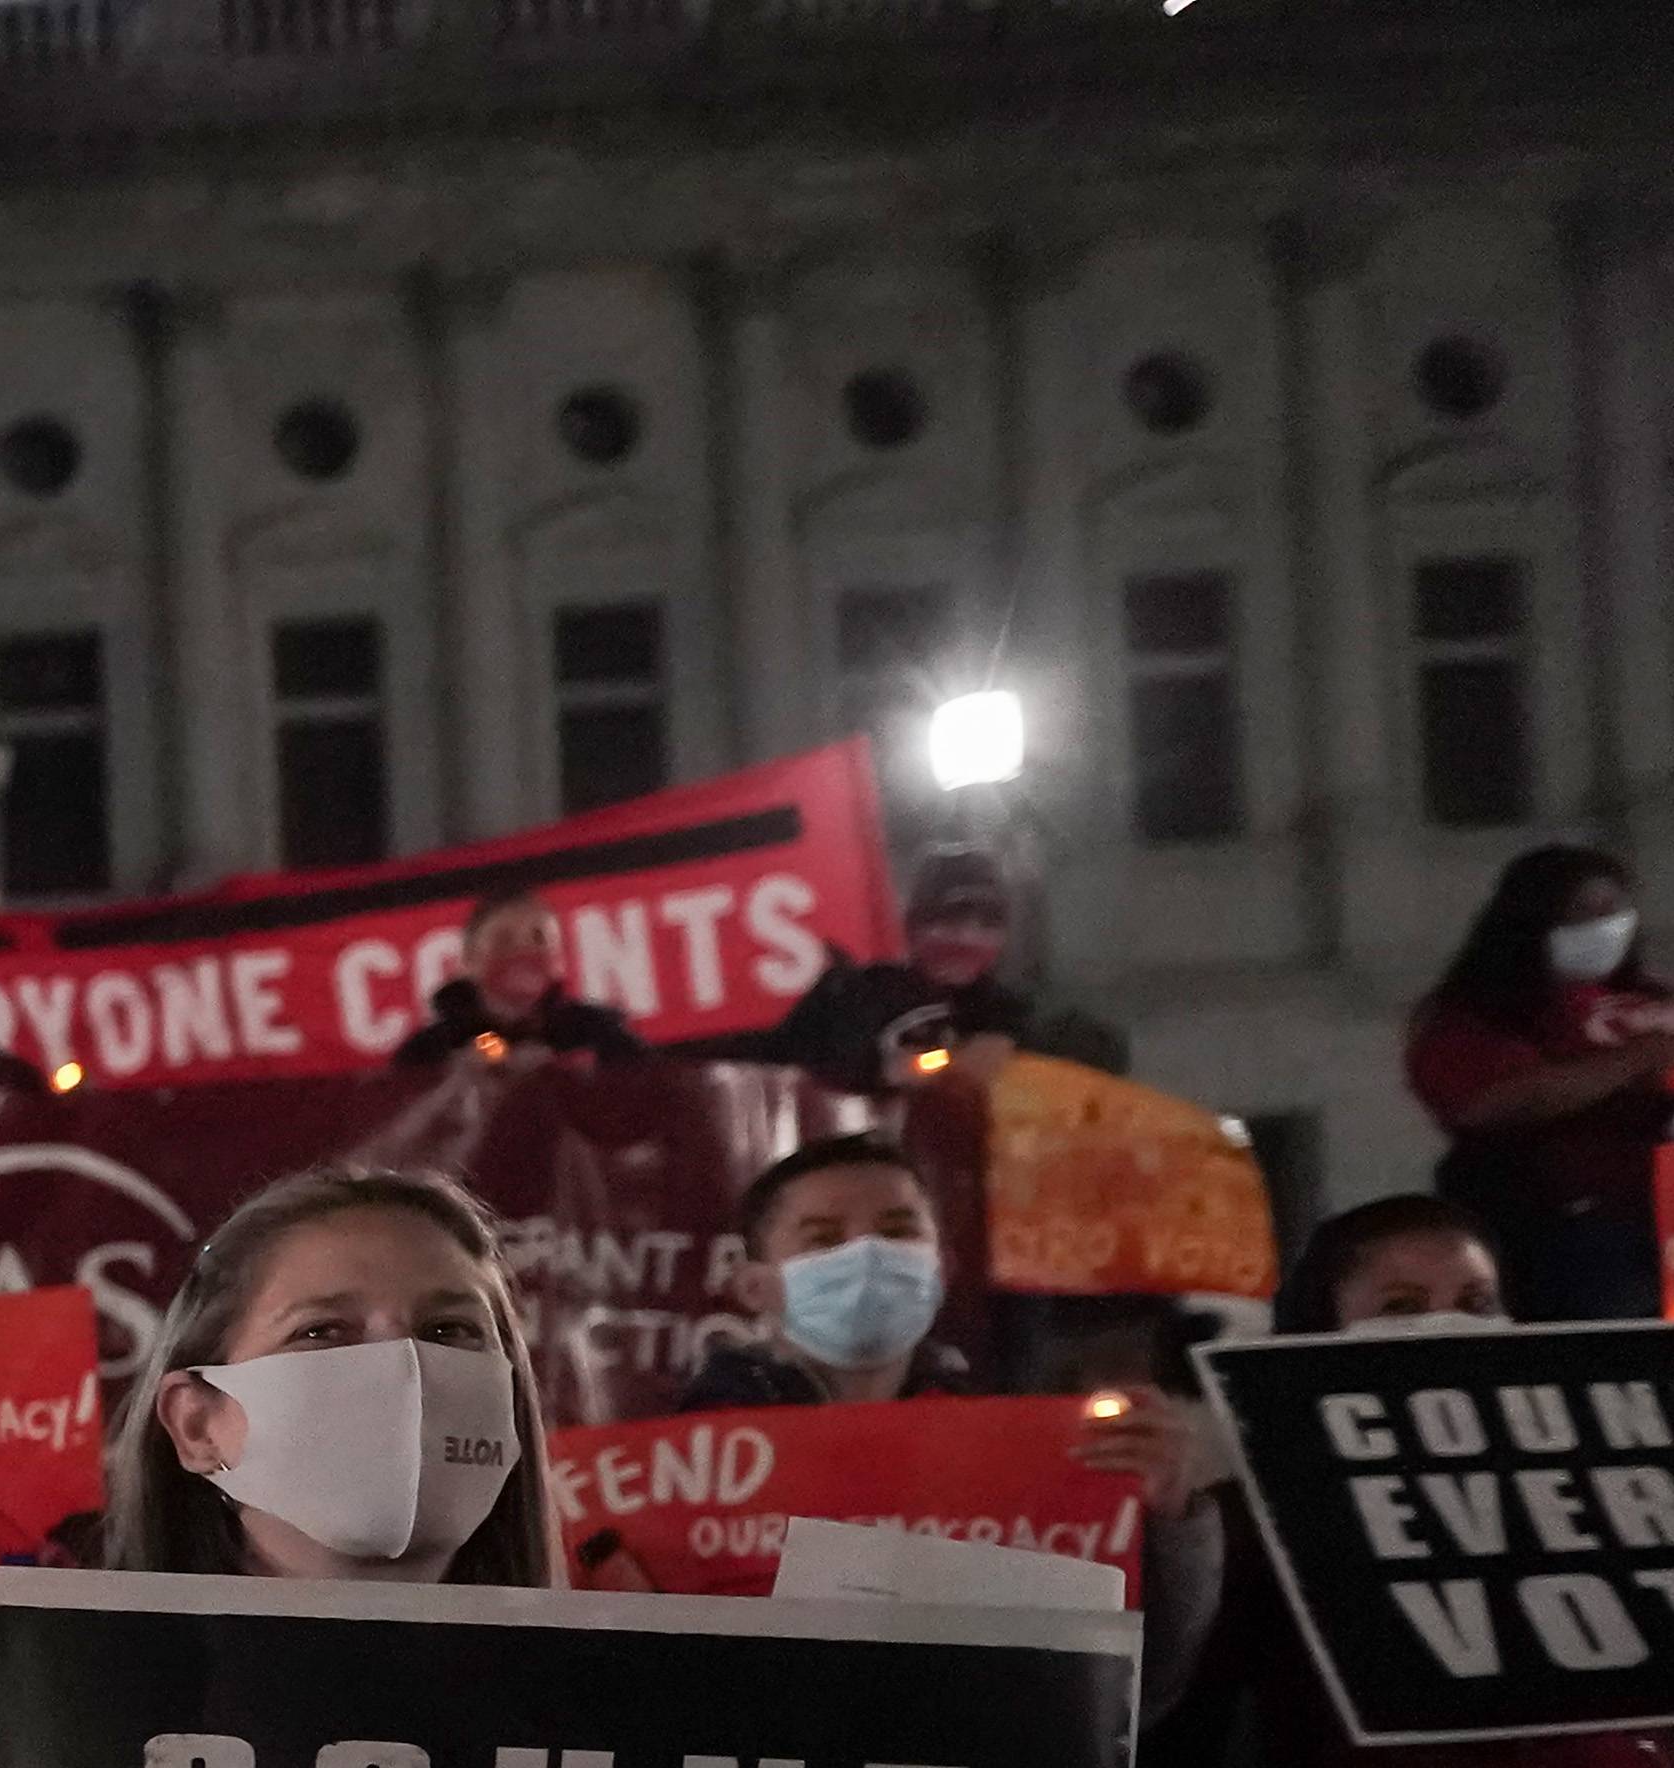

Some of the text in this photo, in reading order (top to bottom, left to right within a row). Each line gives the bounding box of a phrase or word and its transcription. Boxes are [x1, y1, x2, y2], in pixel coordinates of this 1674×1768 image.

[335, 873, 827, 1053] CNTS
[443, 1434, 504, 1467] VOTE
[549, 1424, 775, 1523] FEND
